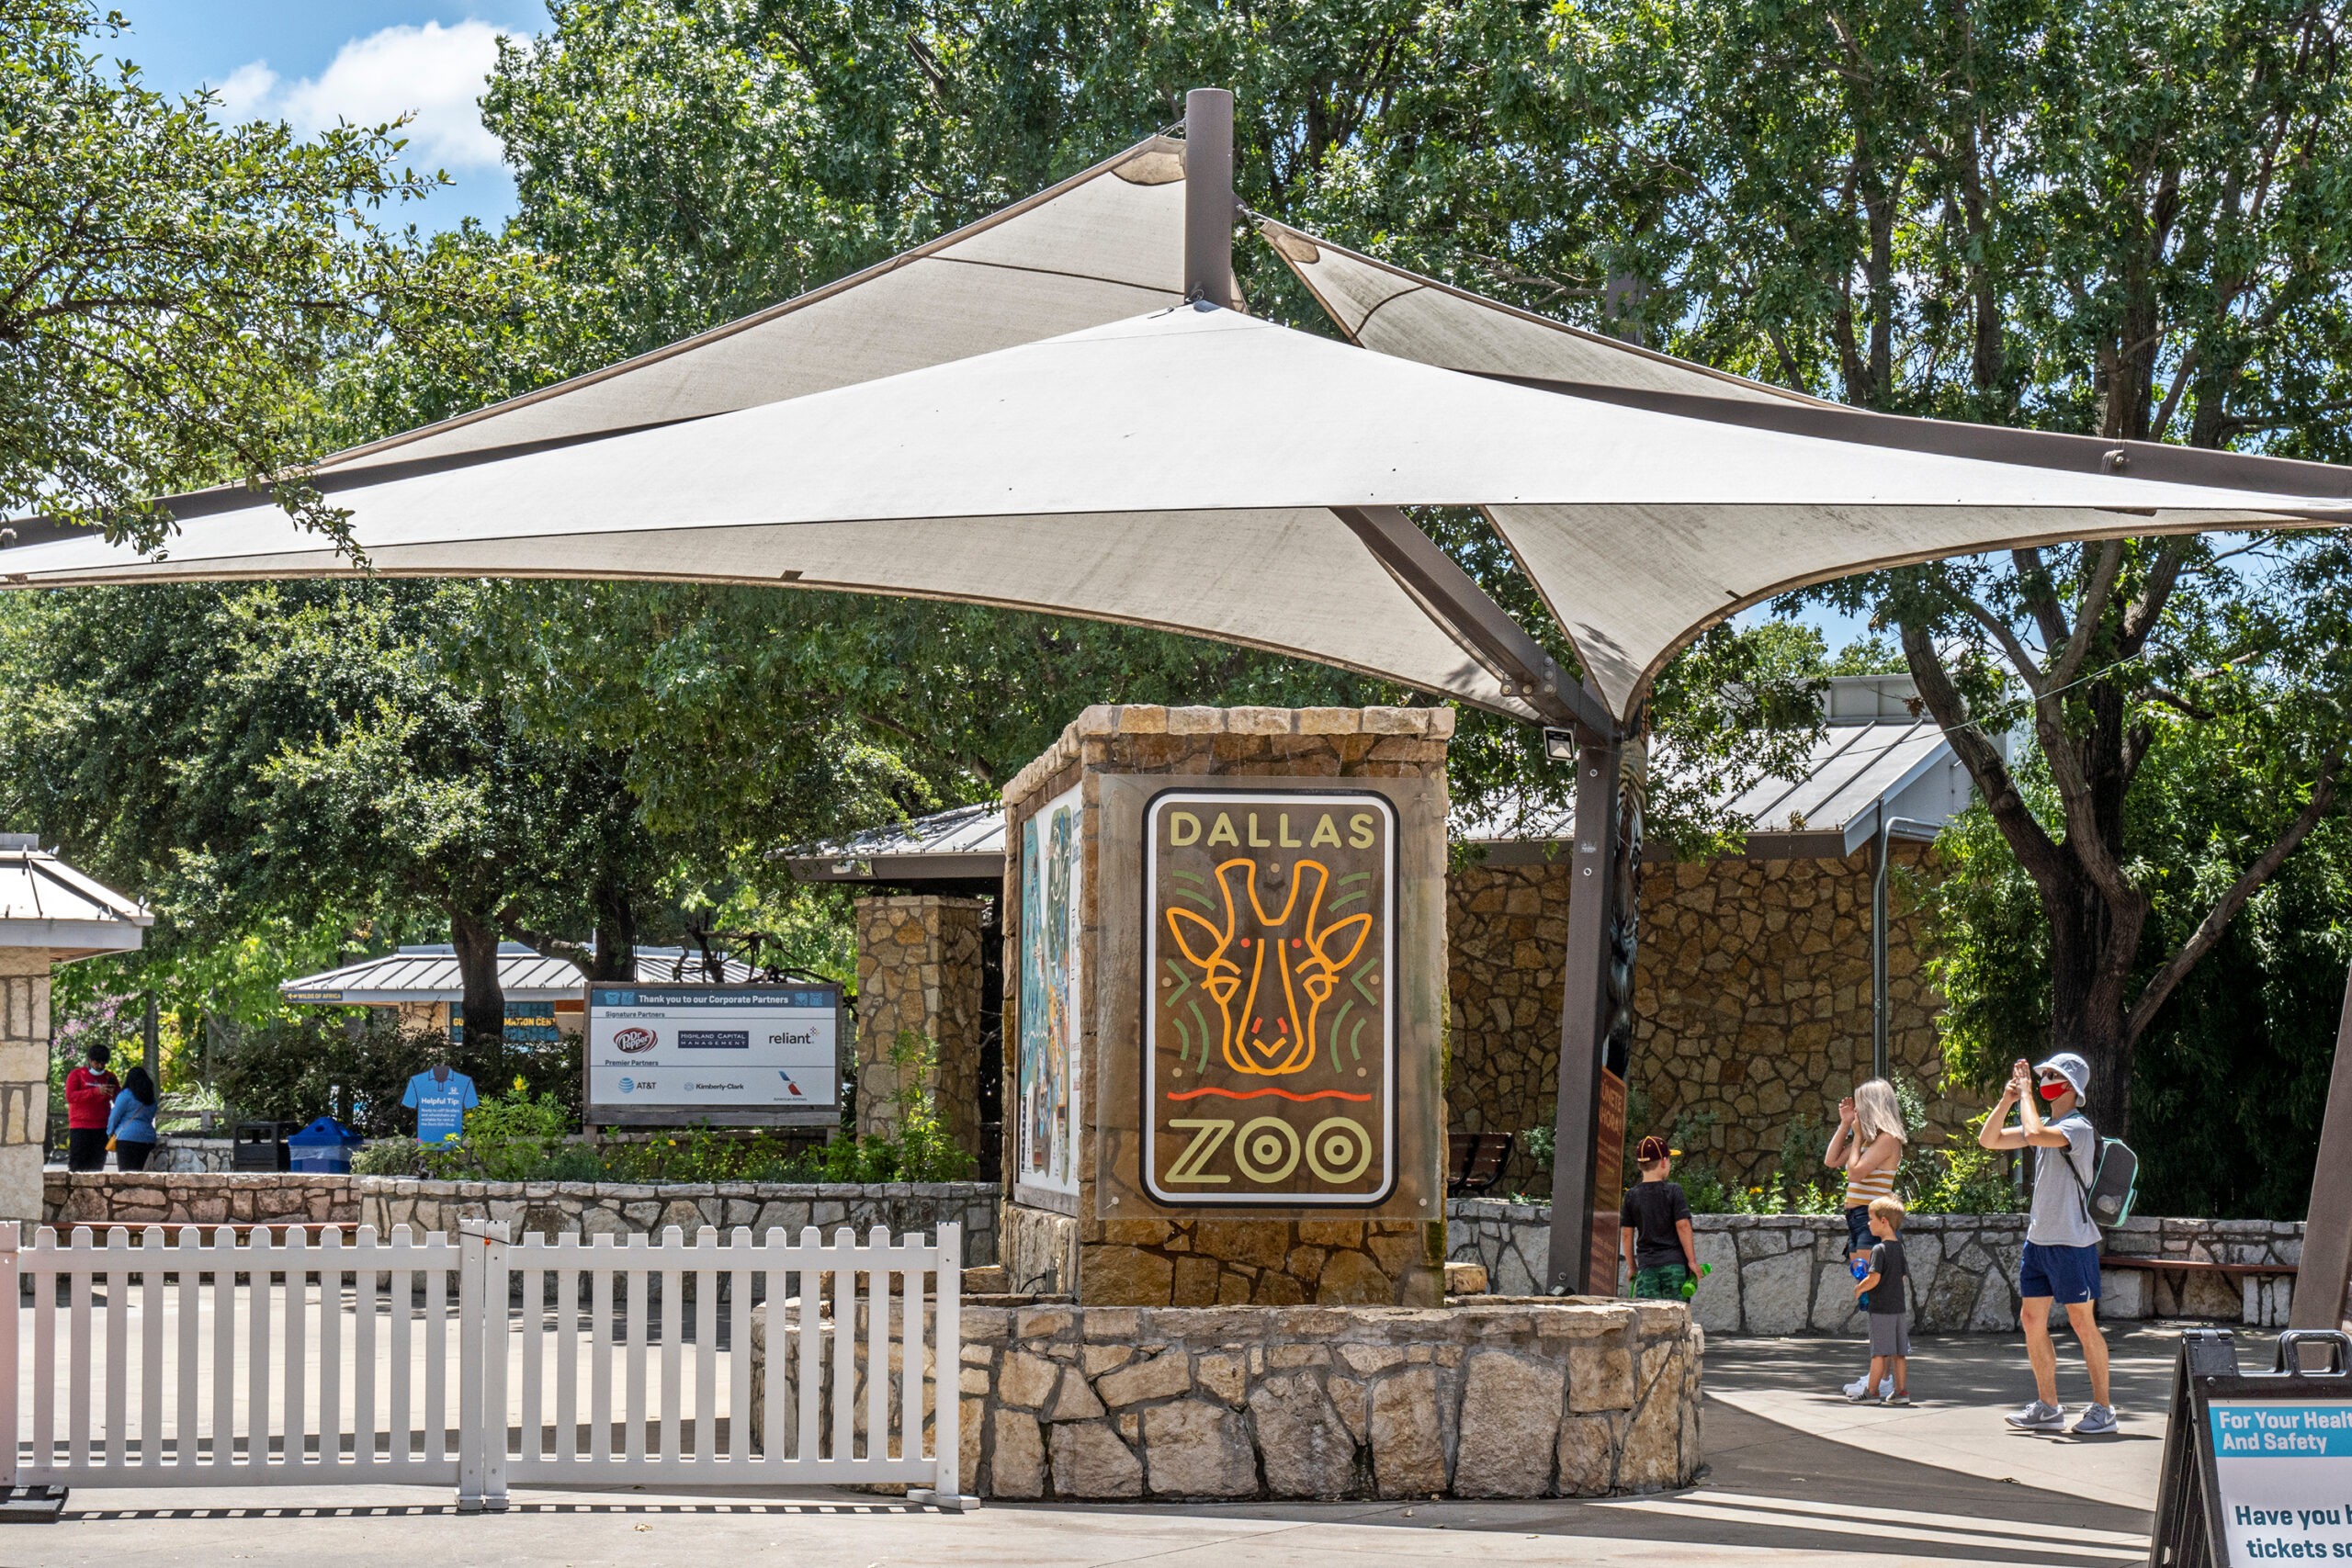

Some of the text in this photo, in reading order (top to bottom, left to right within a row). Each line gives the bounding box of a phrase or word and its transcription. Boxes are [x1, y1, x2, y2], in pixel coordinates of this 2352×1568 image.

[1170, 811, 1375, 849] DALLAS
[639, 994, 664, 1004] Thank
[666, 997, 682, 1006] you
[683, 995, 692, 1004] to
[708, 995, 751, 1006] Corporate
[752, 996, 788, 1004] Partners
[605, 1010, 636, 1019] Signature
[621, 1034, 650, 1050] Pepper
[631, 1032, 641, 1041] Dr
[769, 1032, 810, 1044] reliant
[605, 1059, 659, 1067] Premier Partners
[636, 1081, 656, 1090] AT&T
[695, 1083, 744, 1091] Kimberly-Clark
[1164, 1115, 1373, 1184] ZOO
[2219, 1411, 2251, 1429] For
[2254, 1411, 2300, 1429] Your
[2222, 1432, 2327, 1455] And Safety
[2235, 1506, 2293, 1526] Have
[2297, 1509, 2341, 1531] you
[2246, 1538, 2327, 1559] tickets
